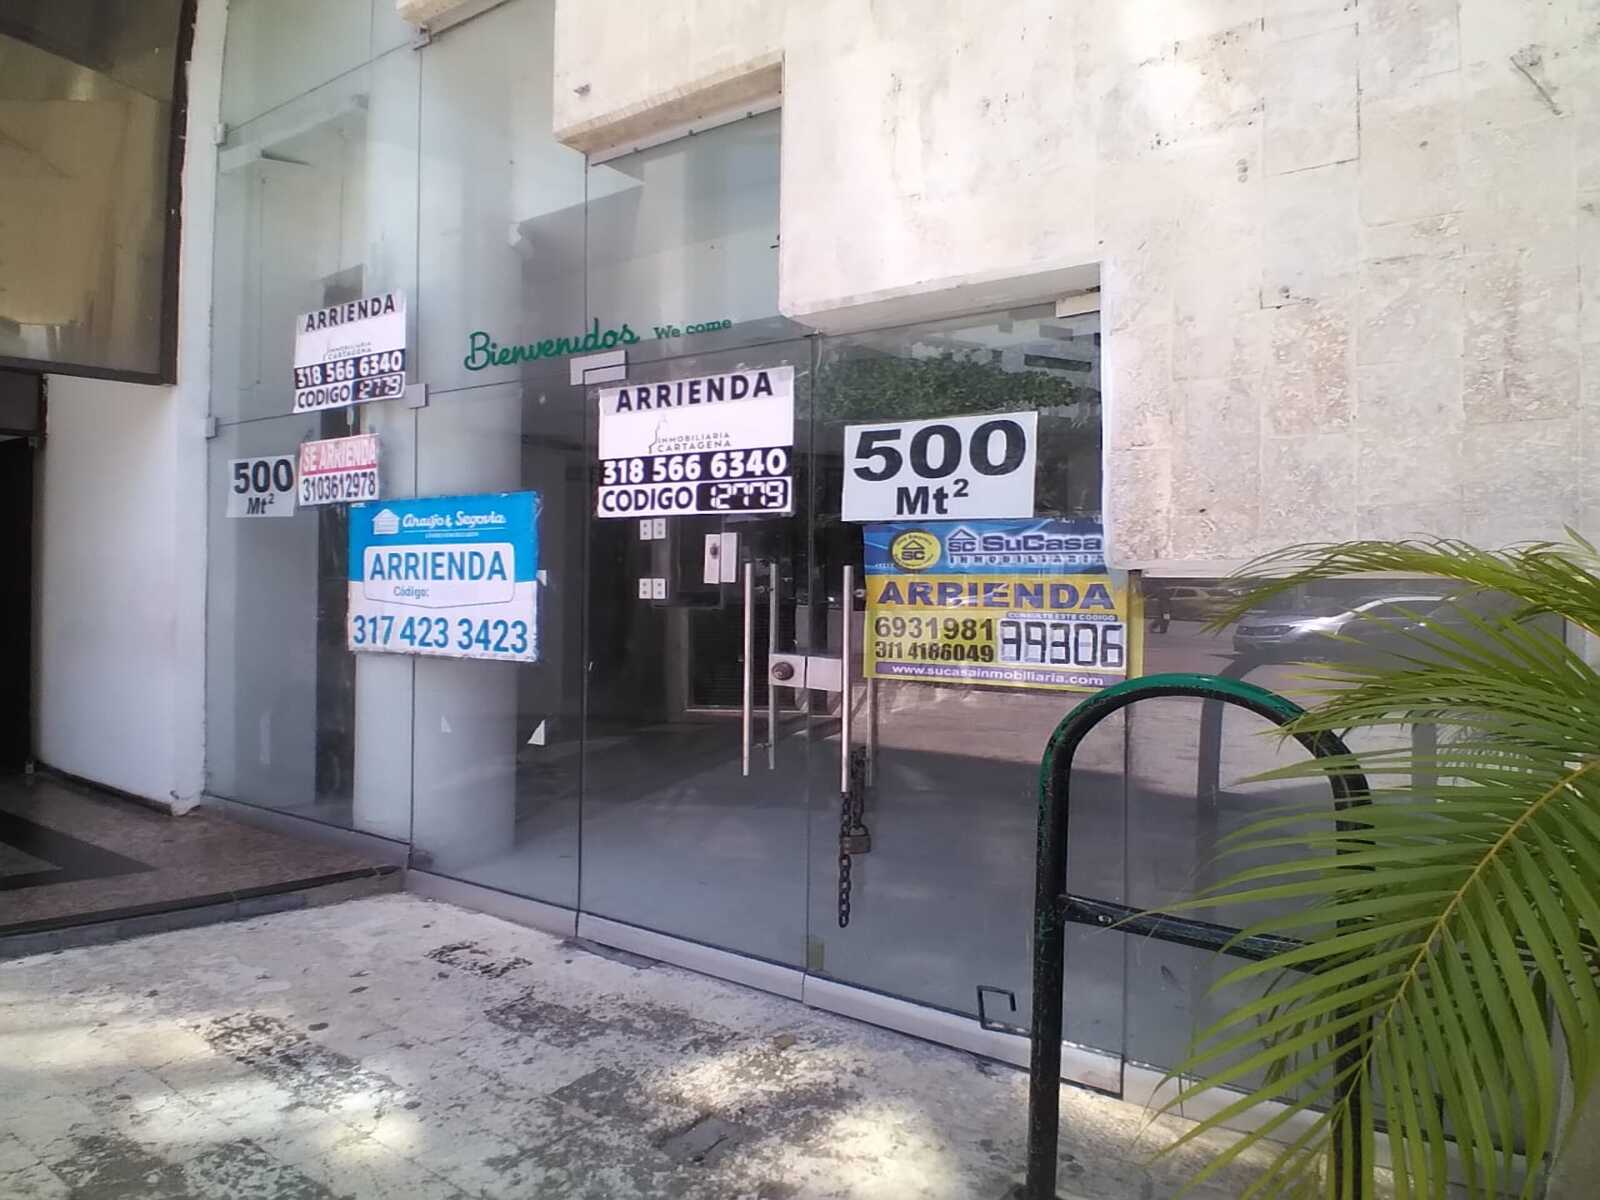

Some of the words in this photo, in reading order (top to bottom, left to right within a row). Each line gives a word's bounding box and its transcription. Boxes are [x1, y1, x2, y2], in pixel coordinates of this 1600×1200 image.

[305, 294, 395, 332] ARRIENDA
[464, 318, 640, 371] Bienvenidos
[297, 366, 321, 387] 318
[325, 359, 354, 382] 566
[360, 351, 402, 377] 6340
[298, 385, 350, 408] CODIGO
[616, 372, 773, 413] ARRIENDA
[657, 432, 730, 444] INMOBILIARIA
[657, 440, 732, 453] CARTAGENA
[853, 419, 1026, 481] 500
[303, 446, 318, 472] SE
[320, 437, 377, 469] ARRIENDA
[603, 458, 644, 485] 318
[652, 454, 701, 482] 566
[711, 448, 787, 478] 6340
[234, 459, 294, 494] 500
[303, 471, 376, 501] 3103612978
[602, 486, 693, 512] CODIGO
[902, 550, 925, 560] SC
[983, 534, 1102, 551] SuCasa
[370, 551, 507, 581] ARRIENDA
[877, 581, 1115, 610] ARRIENDA
[353, 615, 395, 645] 317
[400, 616, 449, 648] 423
[457, 618, 528, 653] 3423
[875, 616, 993, 641] 6931981
[875, 641, 904, 658] 311
[892, 664, 1104, 686] www.sucasainmobiliaria.com
